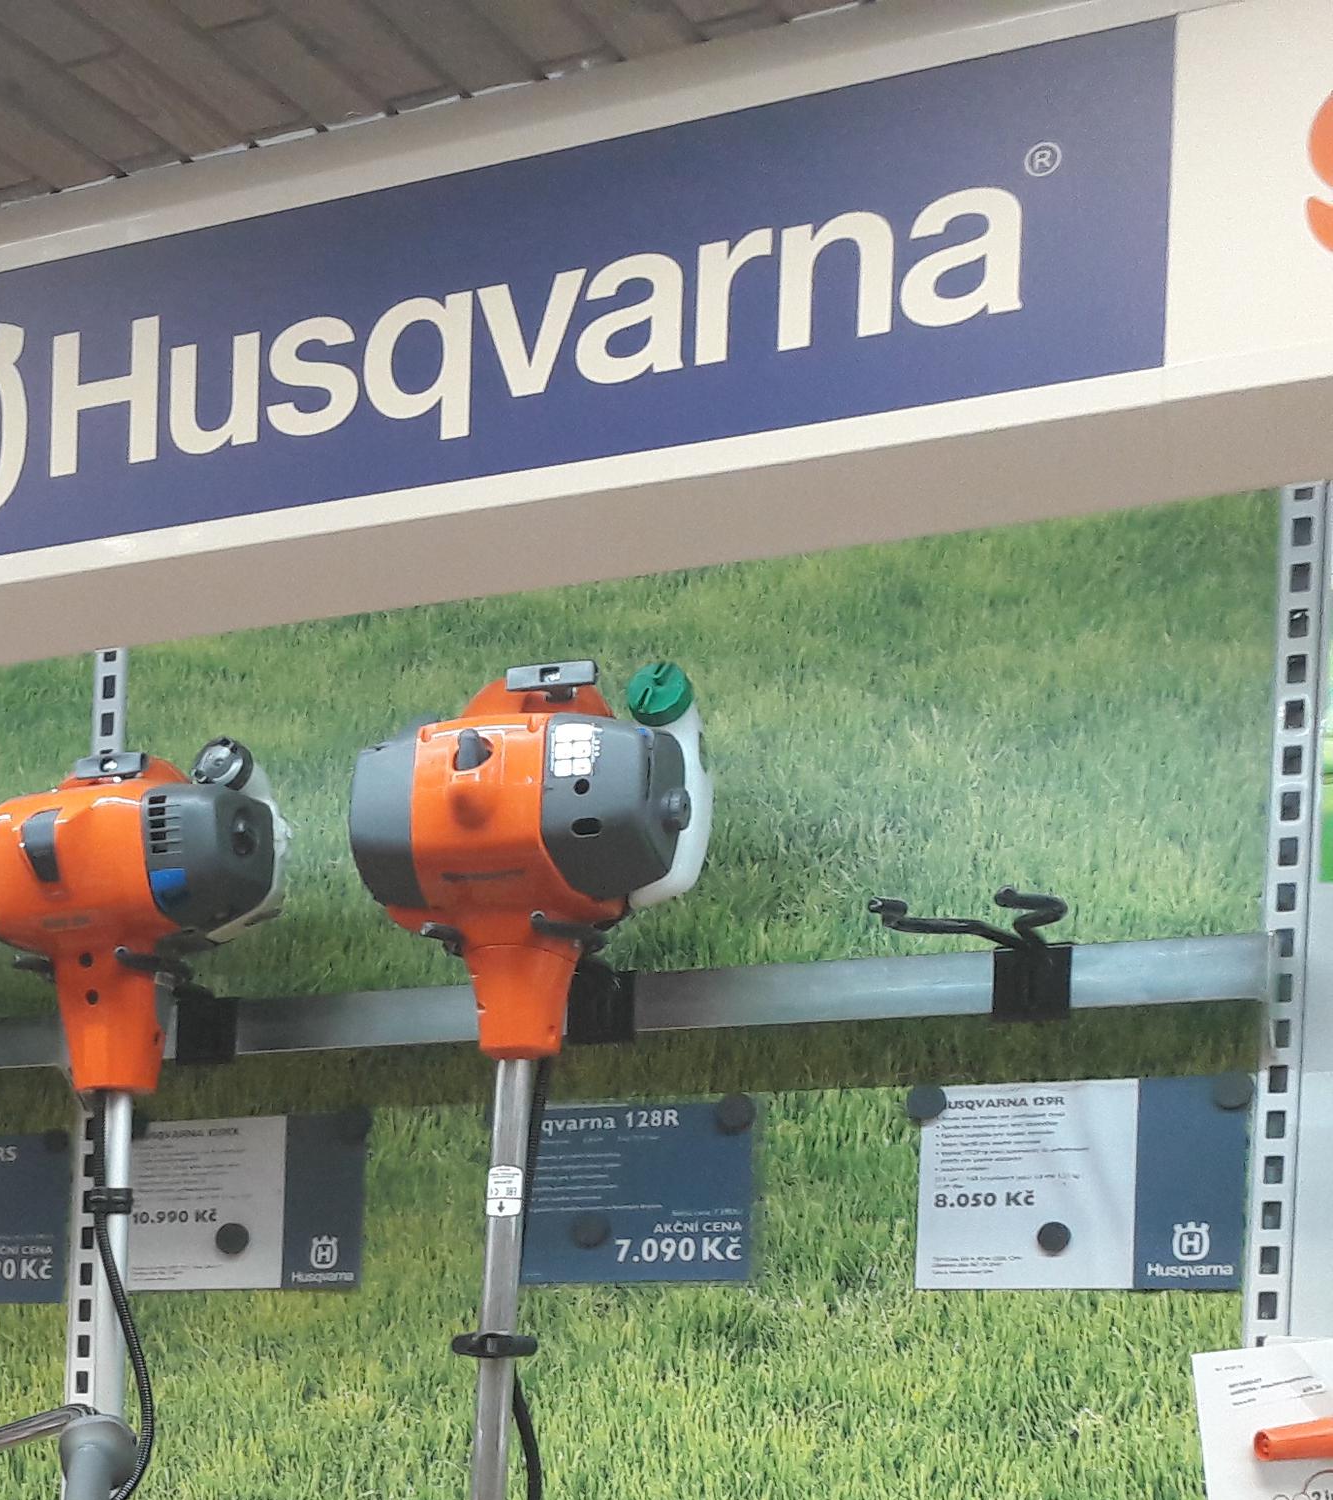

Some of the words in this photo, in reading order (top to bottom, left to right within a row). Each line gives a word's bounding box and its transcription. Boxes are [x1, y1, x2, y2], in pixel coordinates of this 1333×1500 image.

[945, 1097, 1028, 1111] USQVARNA
[540, 1113, 616, 1137] qvarna
[624, 1109, 680, 1129] 128R
[934, 1192, 997, 1208] 8.050
[1005, 1190, 1036, 1206] Kč
[194, 1208, 217, 1223] Kč
[653, 1219, 699, 1234] AKČNÍ
[702, 1220, 743, 1233] CENA
[615, 1237, 696, 1263] 7.090
[702, 1236, 743, 1262] Kč
[20, 1258, 54, 1280] Kč
[1146, 1262, 1234, 1279] Husqvarna
